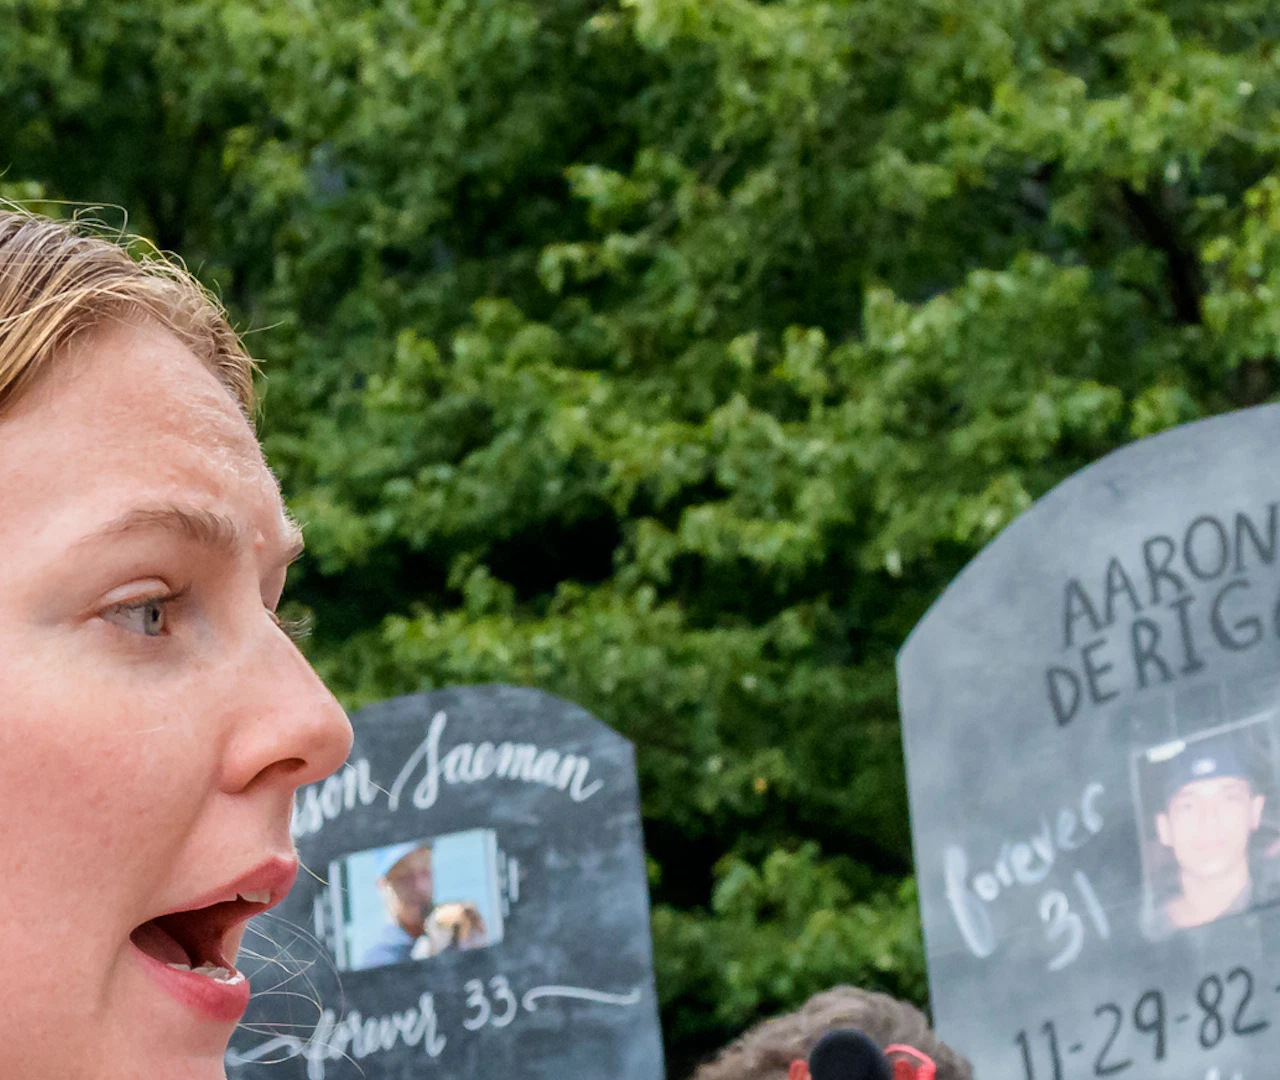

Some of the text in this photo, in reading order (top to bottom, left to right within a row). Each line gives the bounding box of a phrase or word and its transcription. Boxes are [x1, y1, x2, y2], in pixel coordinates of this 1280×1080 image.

[1063, 503, 1279, 648] AARON
[945, 783, 1105, 958] forever
[1040, 871, 1109, 970] 31
[462, 974, 519, 1031] 33
